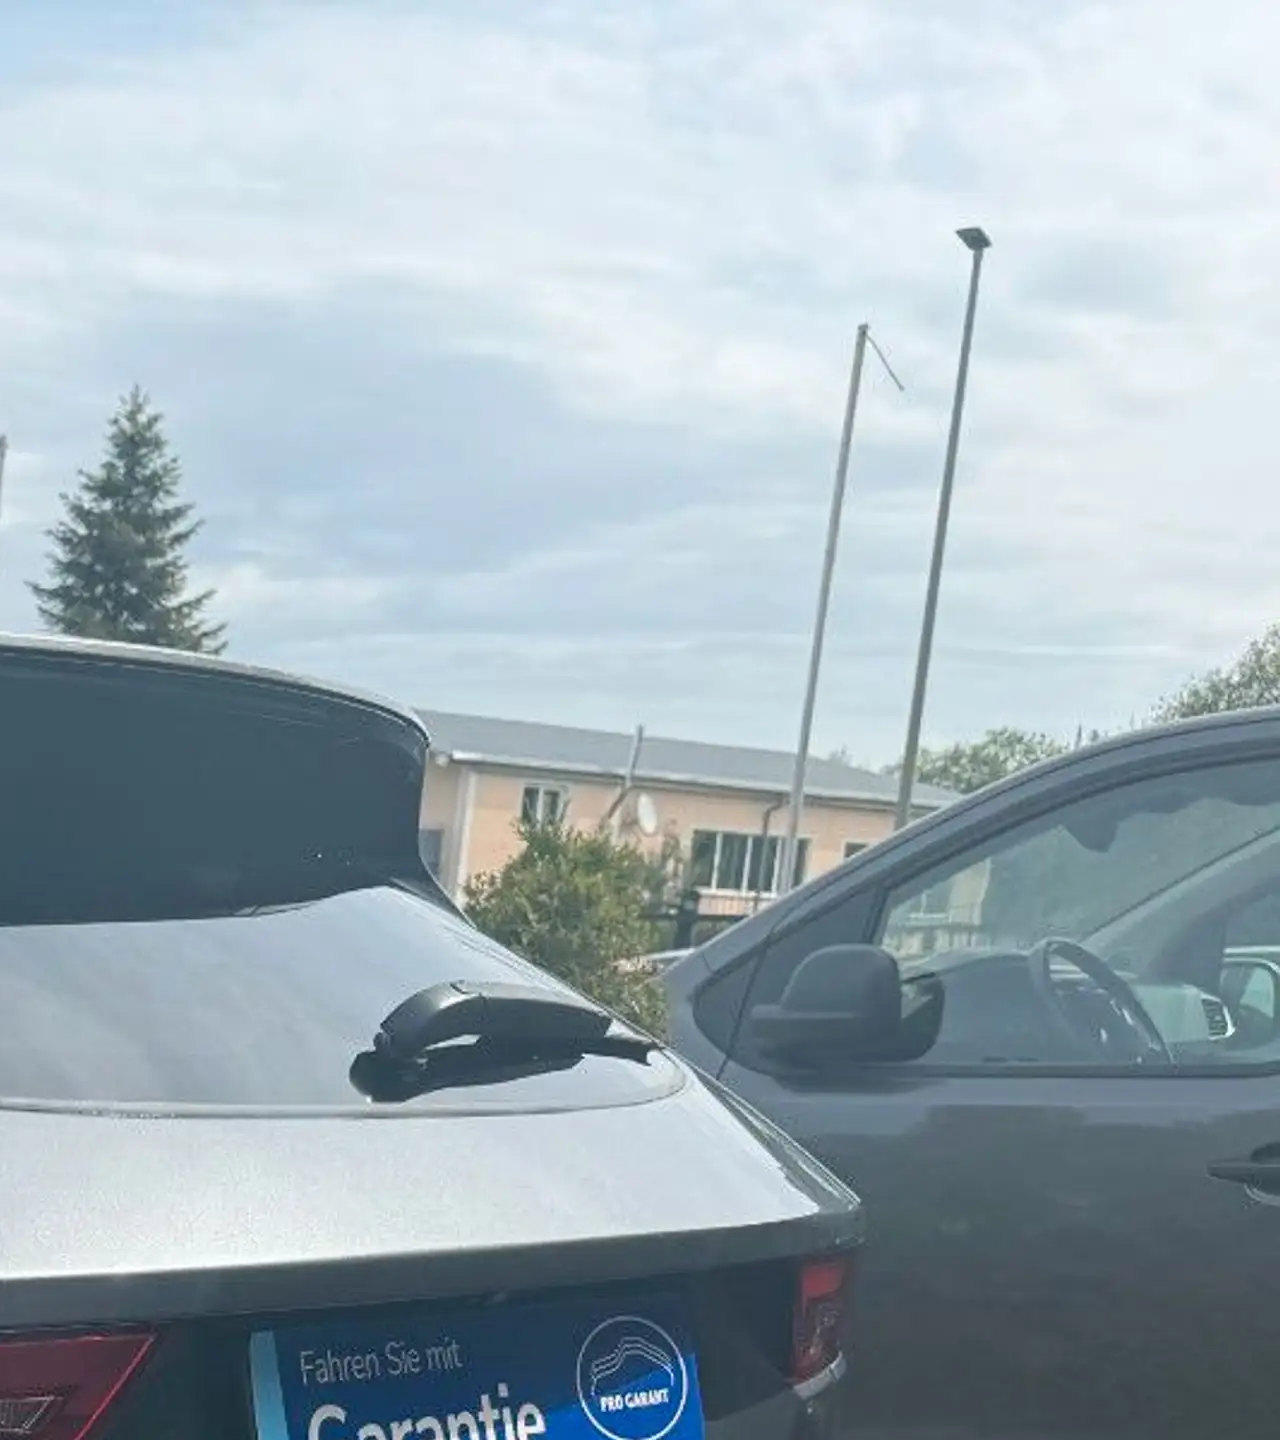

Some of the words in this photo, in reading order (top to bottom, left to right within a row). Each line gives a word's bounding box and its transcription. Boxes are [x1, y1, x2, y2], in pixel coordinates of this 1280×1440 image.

[300, 1349, 381, 1385] Fahren
[385, 1341, 420, 1375] Sie
[425, 1336, 463, 1370] mit
[600, 1394, 624, 1412] PRO
[625, 1388, 669, 1409] GARANT
